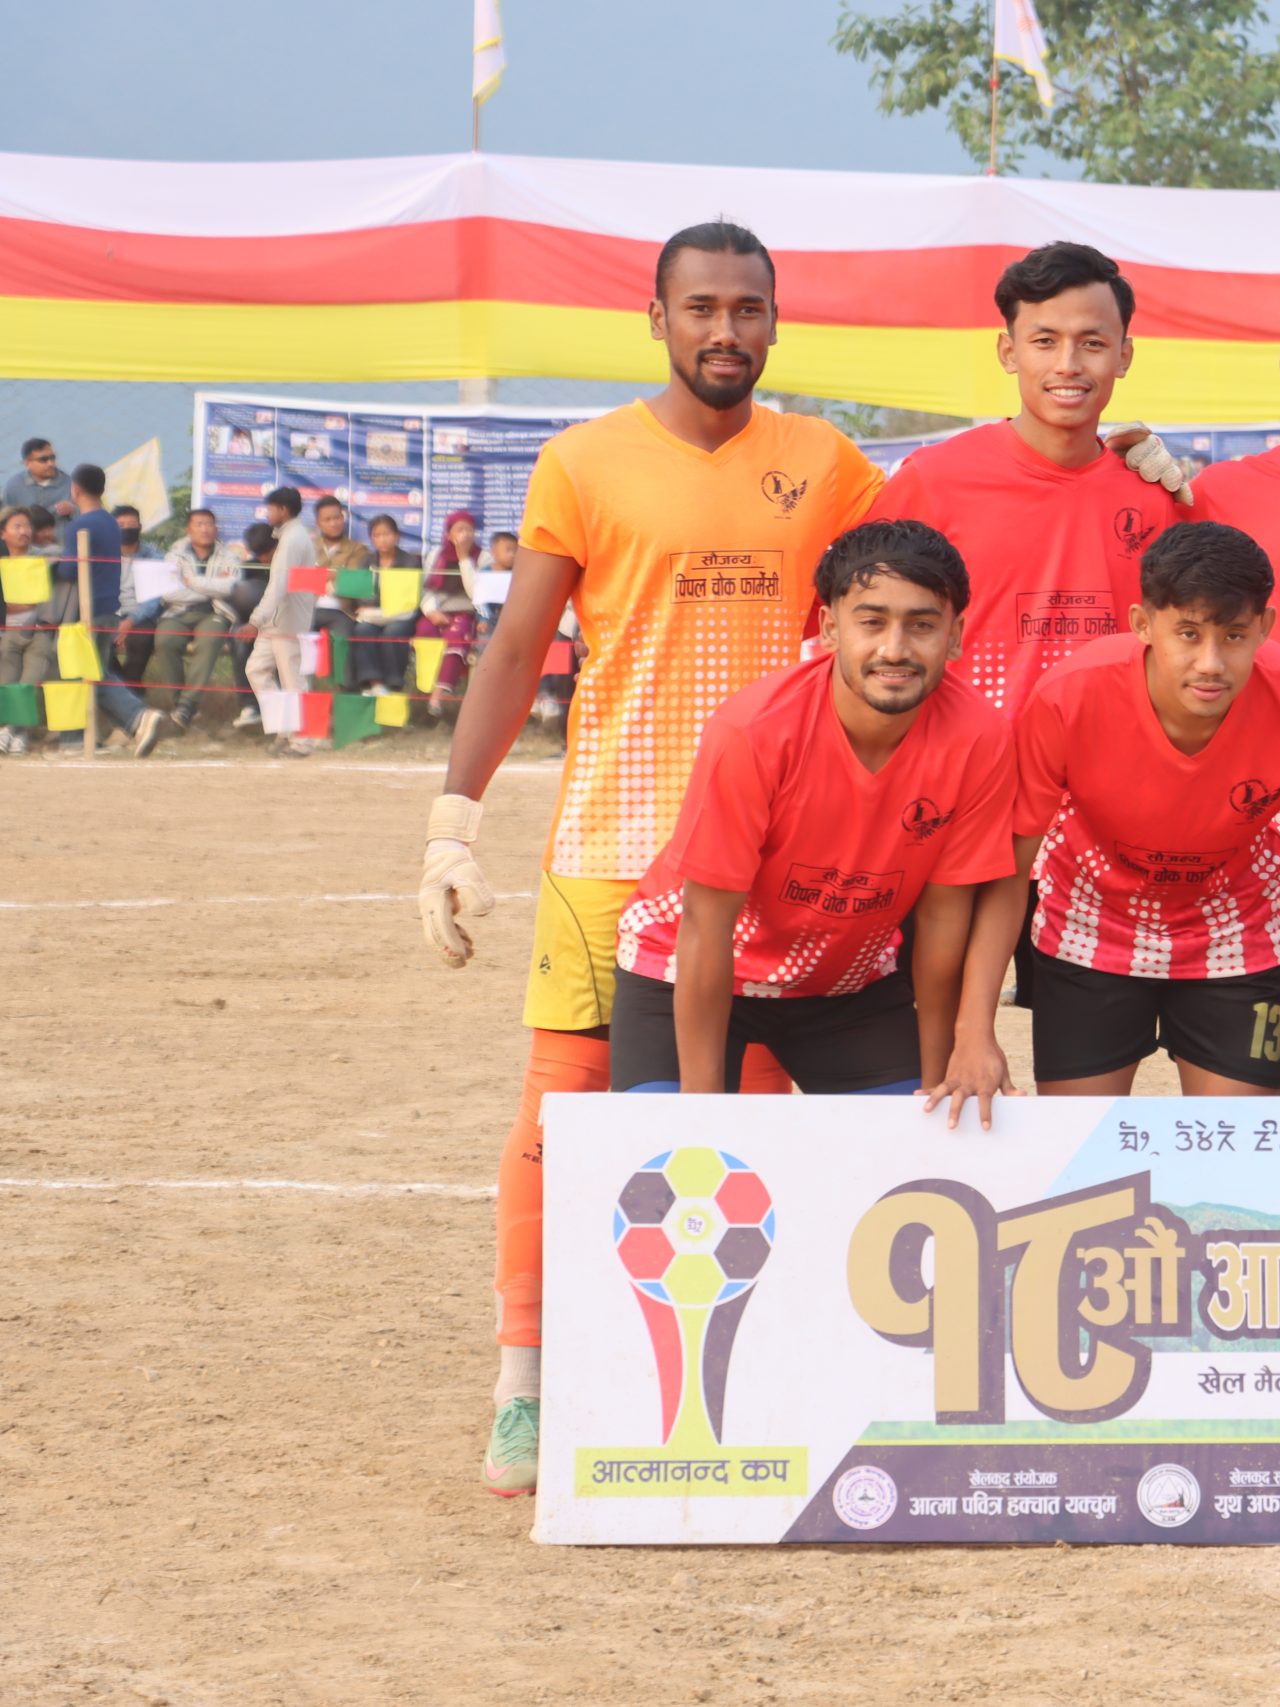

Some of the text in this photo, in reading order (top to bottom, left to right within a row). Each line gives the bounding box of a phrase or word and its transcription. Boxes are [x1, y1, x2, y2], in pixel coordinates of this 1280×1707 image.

[675, 573, 707, 598] पिपल
[711, 572, 736, 597] चोक
[1198, 1366, 1246, 1394] खेल
[592, 1459, 790, 1484] आत्मानन्द कप
[909, 1495, 957, 1516] आत्मा
[962, 1491, 1001, 1517] पवित्र
[1247, 1494, 1279, 1514] अफ
